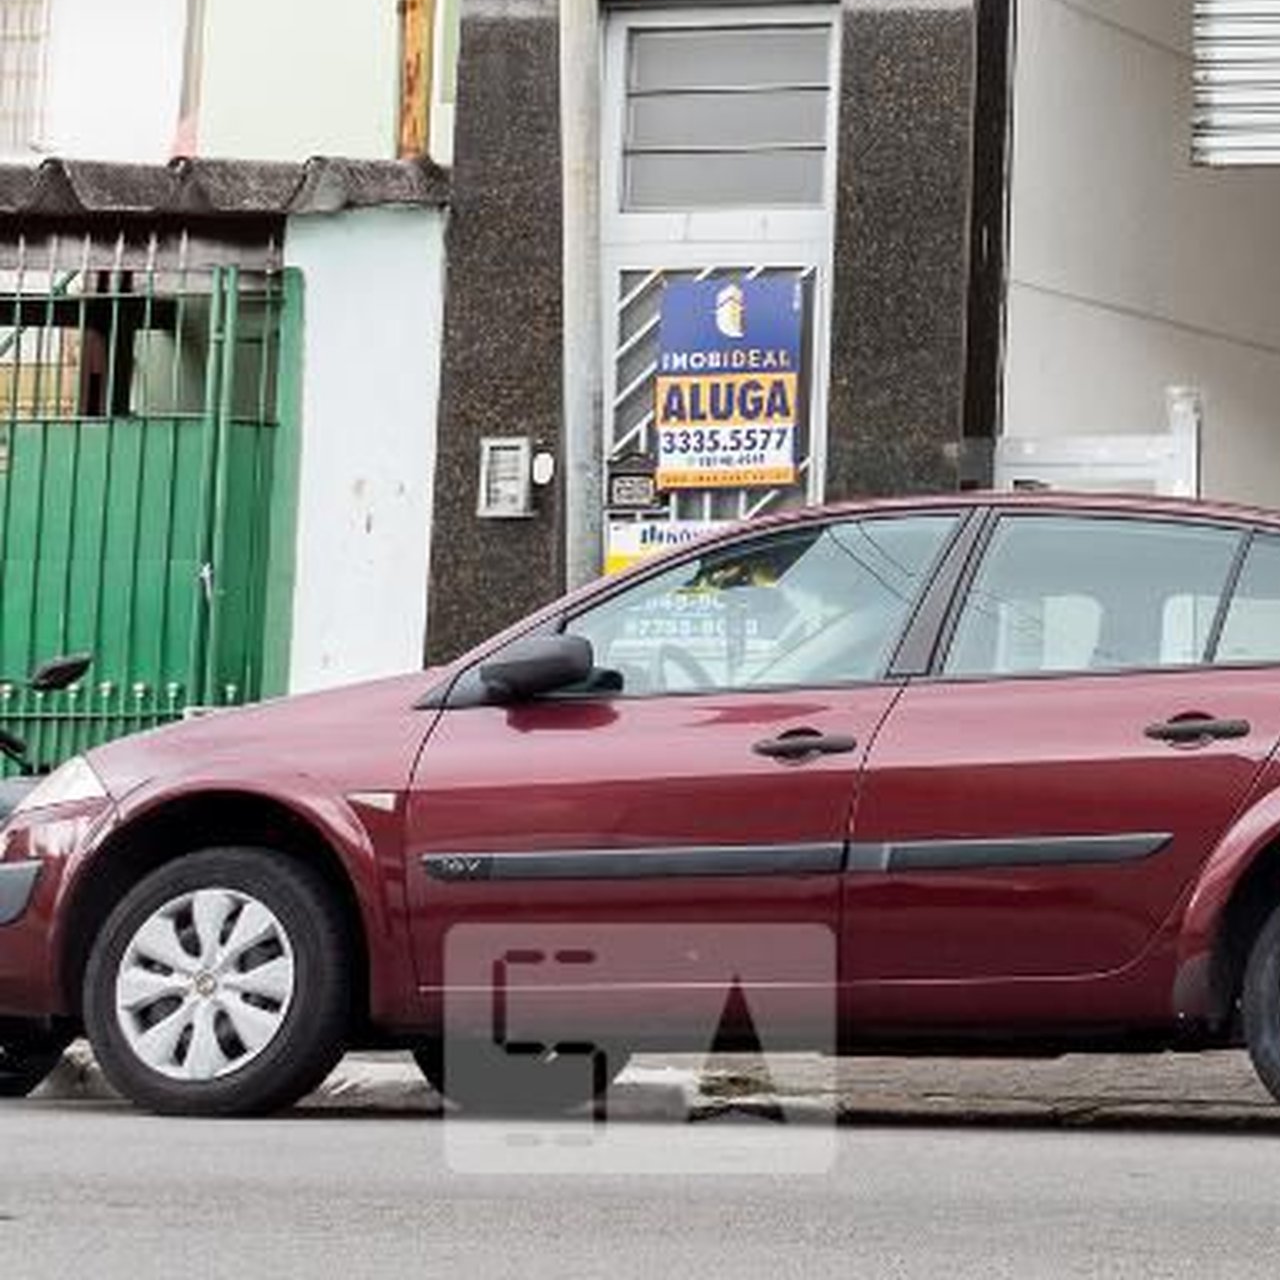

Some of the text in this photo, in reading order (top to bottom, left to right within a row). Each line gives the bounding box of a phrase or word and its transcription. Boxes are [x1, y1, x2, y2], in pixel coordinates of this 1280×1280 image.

[661, 348, 791, 371] IMOBIDEAL
[660, 380, 791, 422] ALUGA
[662, 428, 788, 455] 3335.5577
